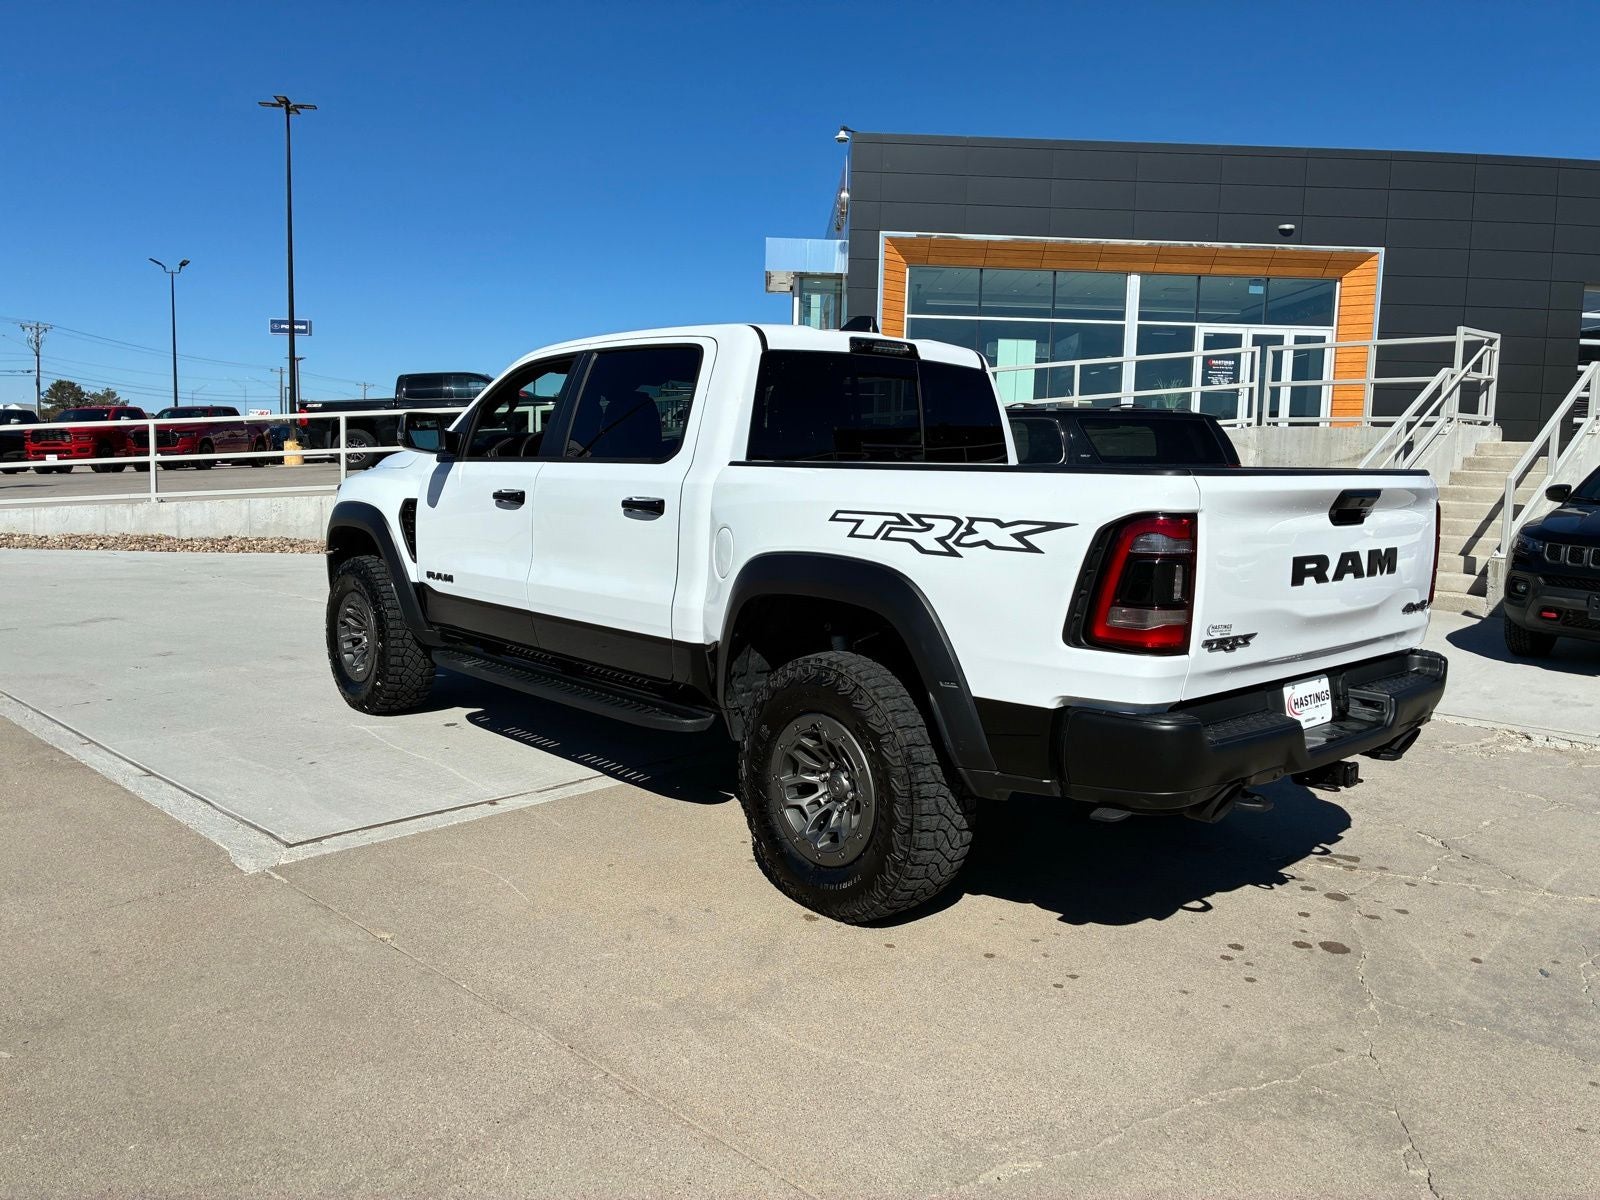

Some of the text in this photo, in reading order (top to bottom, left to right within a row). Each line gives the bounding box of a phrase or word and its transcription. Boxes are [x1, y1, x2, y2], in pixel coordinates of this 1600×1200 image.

[828, 509, 1079, 559] TRX
[426, 571, 454, 584] RAM
[1291, 547, 1397, 587] RAM
[1293, 690, 1330, 710] HASTINGS
